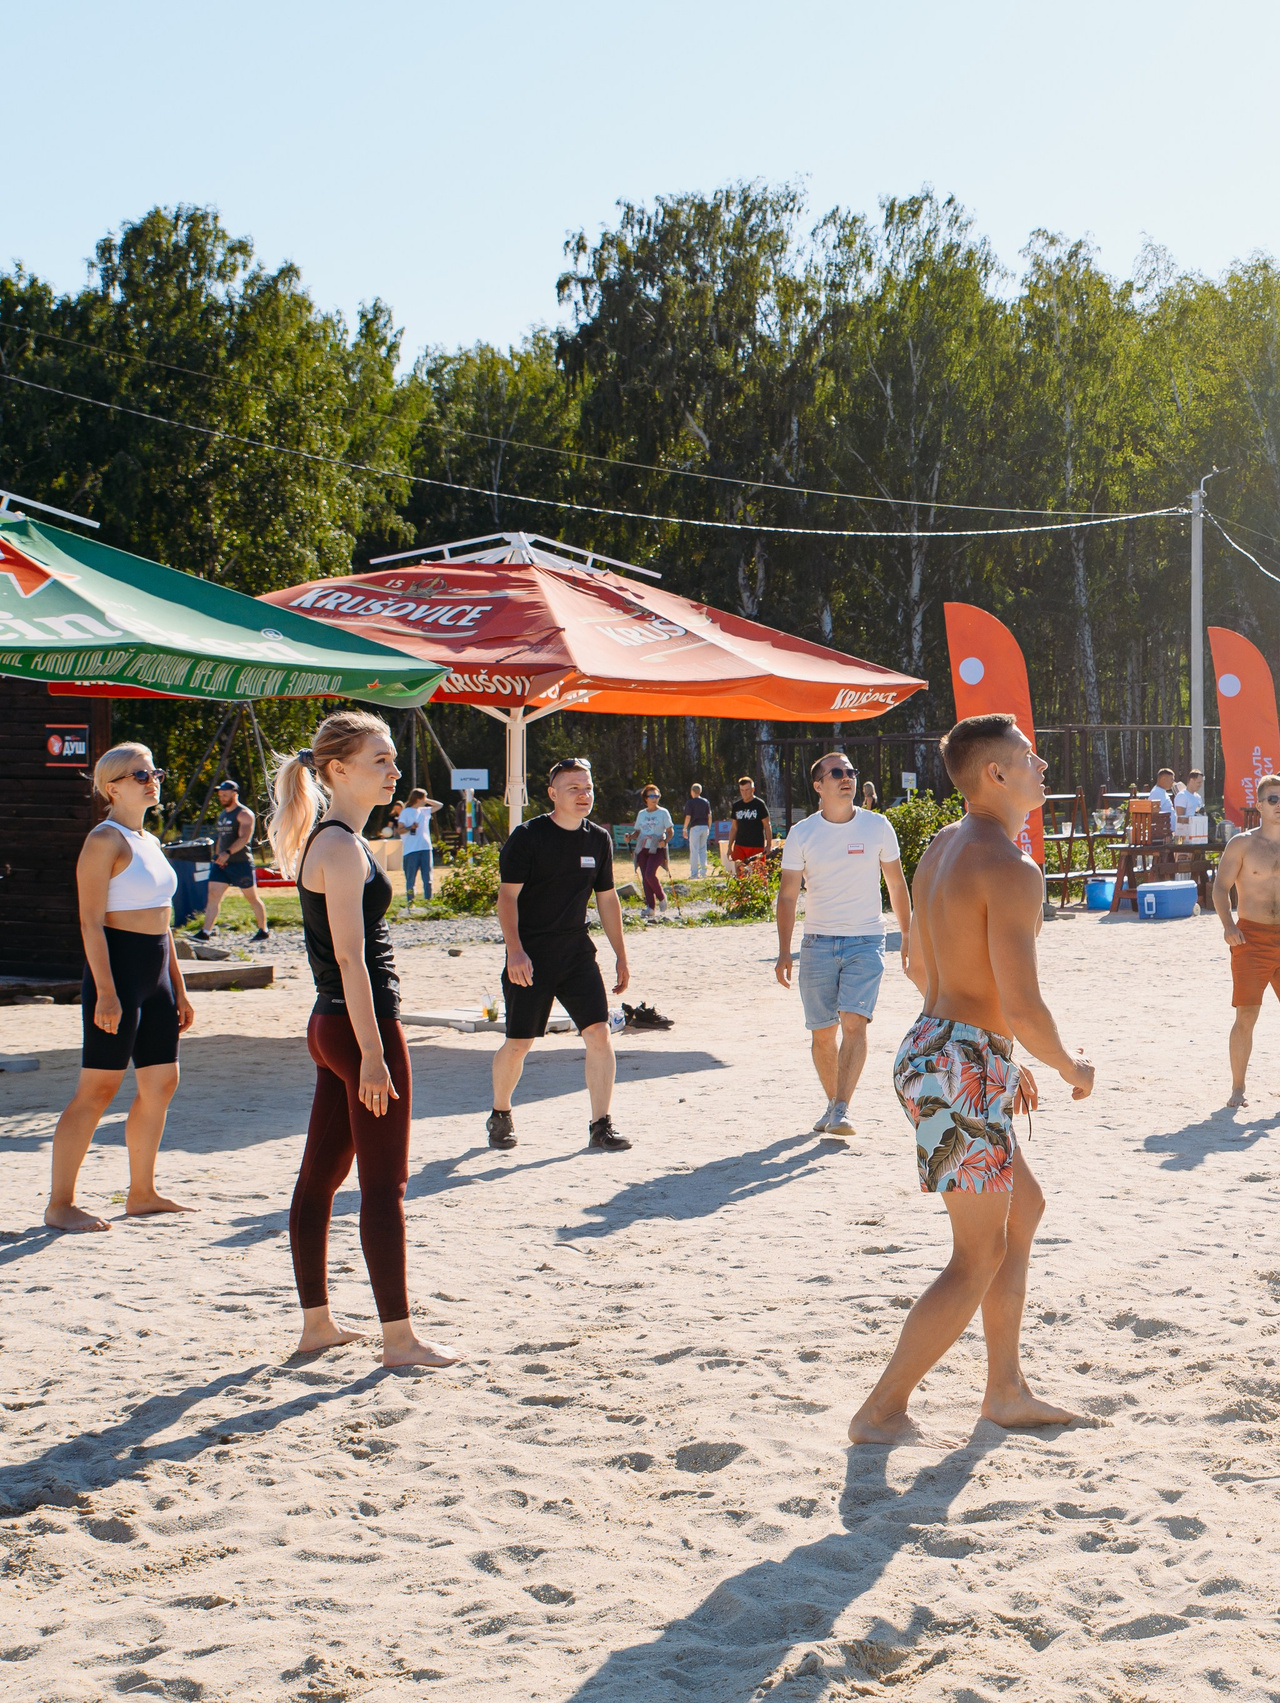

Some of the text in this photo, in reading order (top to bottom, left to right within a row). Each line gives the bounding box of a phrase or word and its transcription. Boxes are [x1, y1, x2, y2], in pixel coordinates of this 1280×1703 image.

[288, 587, 493, 627] KRUŠOVICE
[189, 658, 241, 695] ВРЕДИТ
[235, 666, 288, 697] ВАШЕМУ
[439, 669, 536, 697] KRUŠOVI
[62, 741, 86, 757] ДУШ
